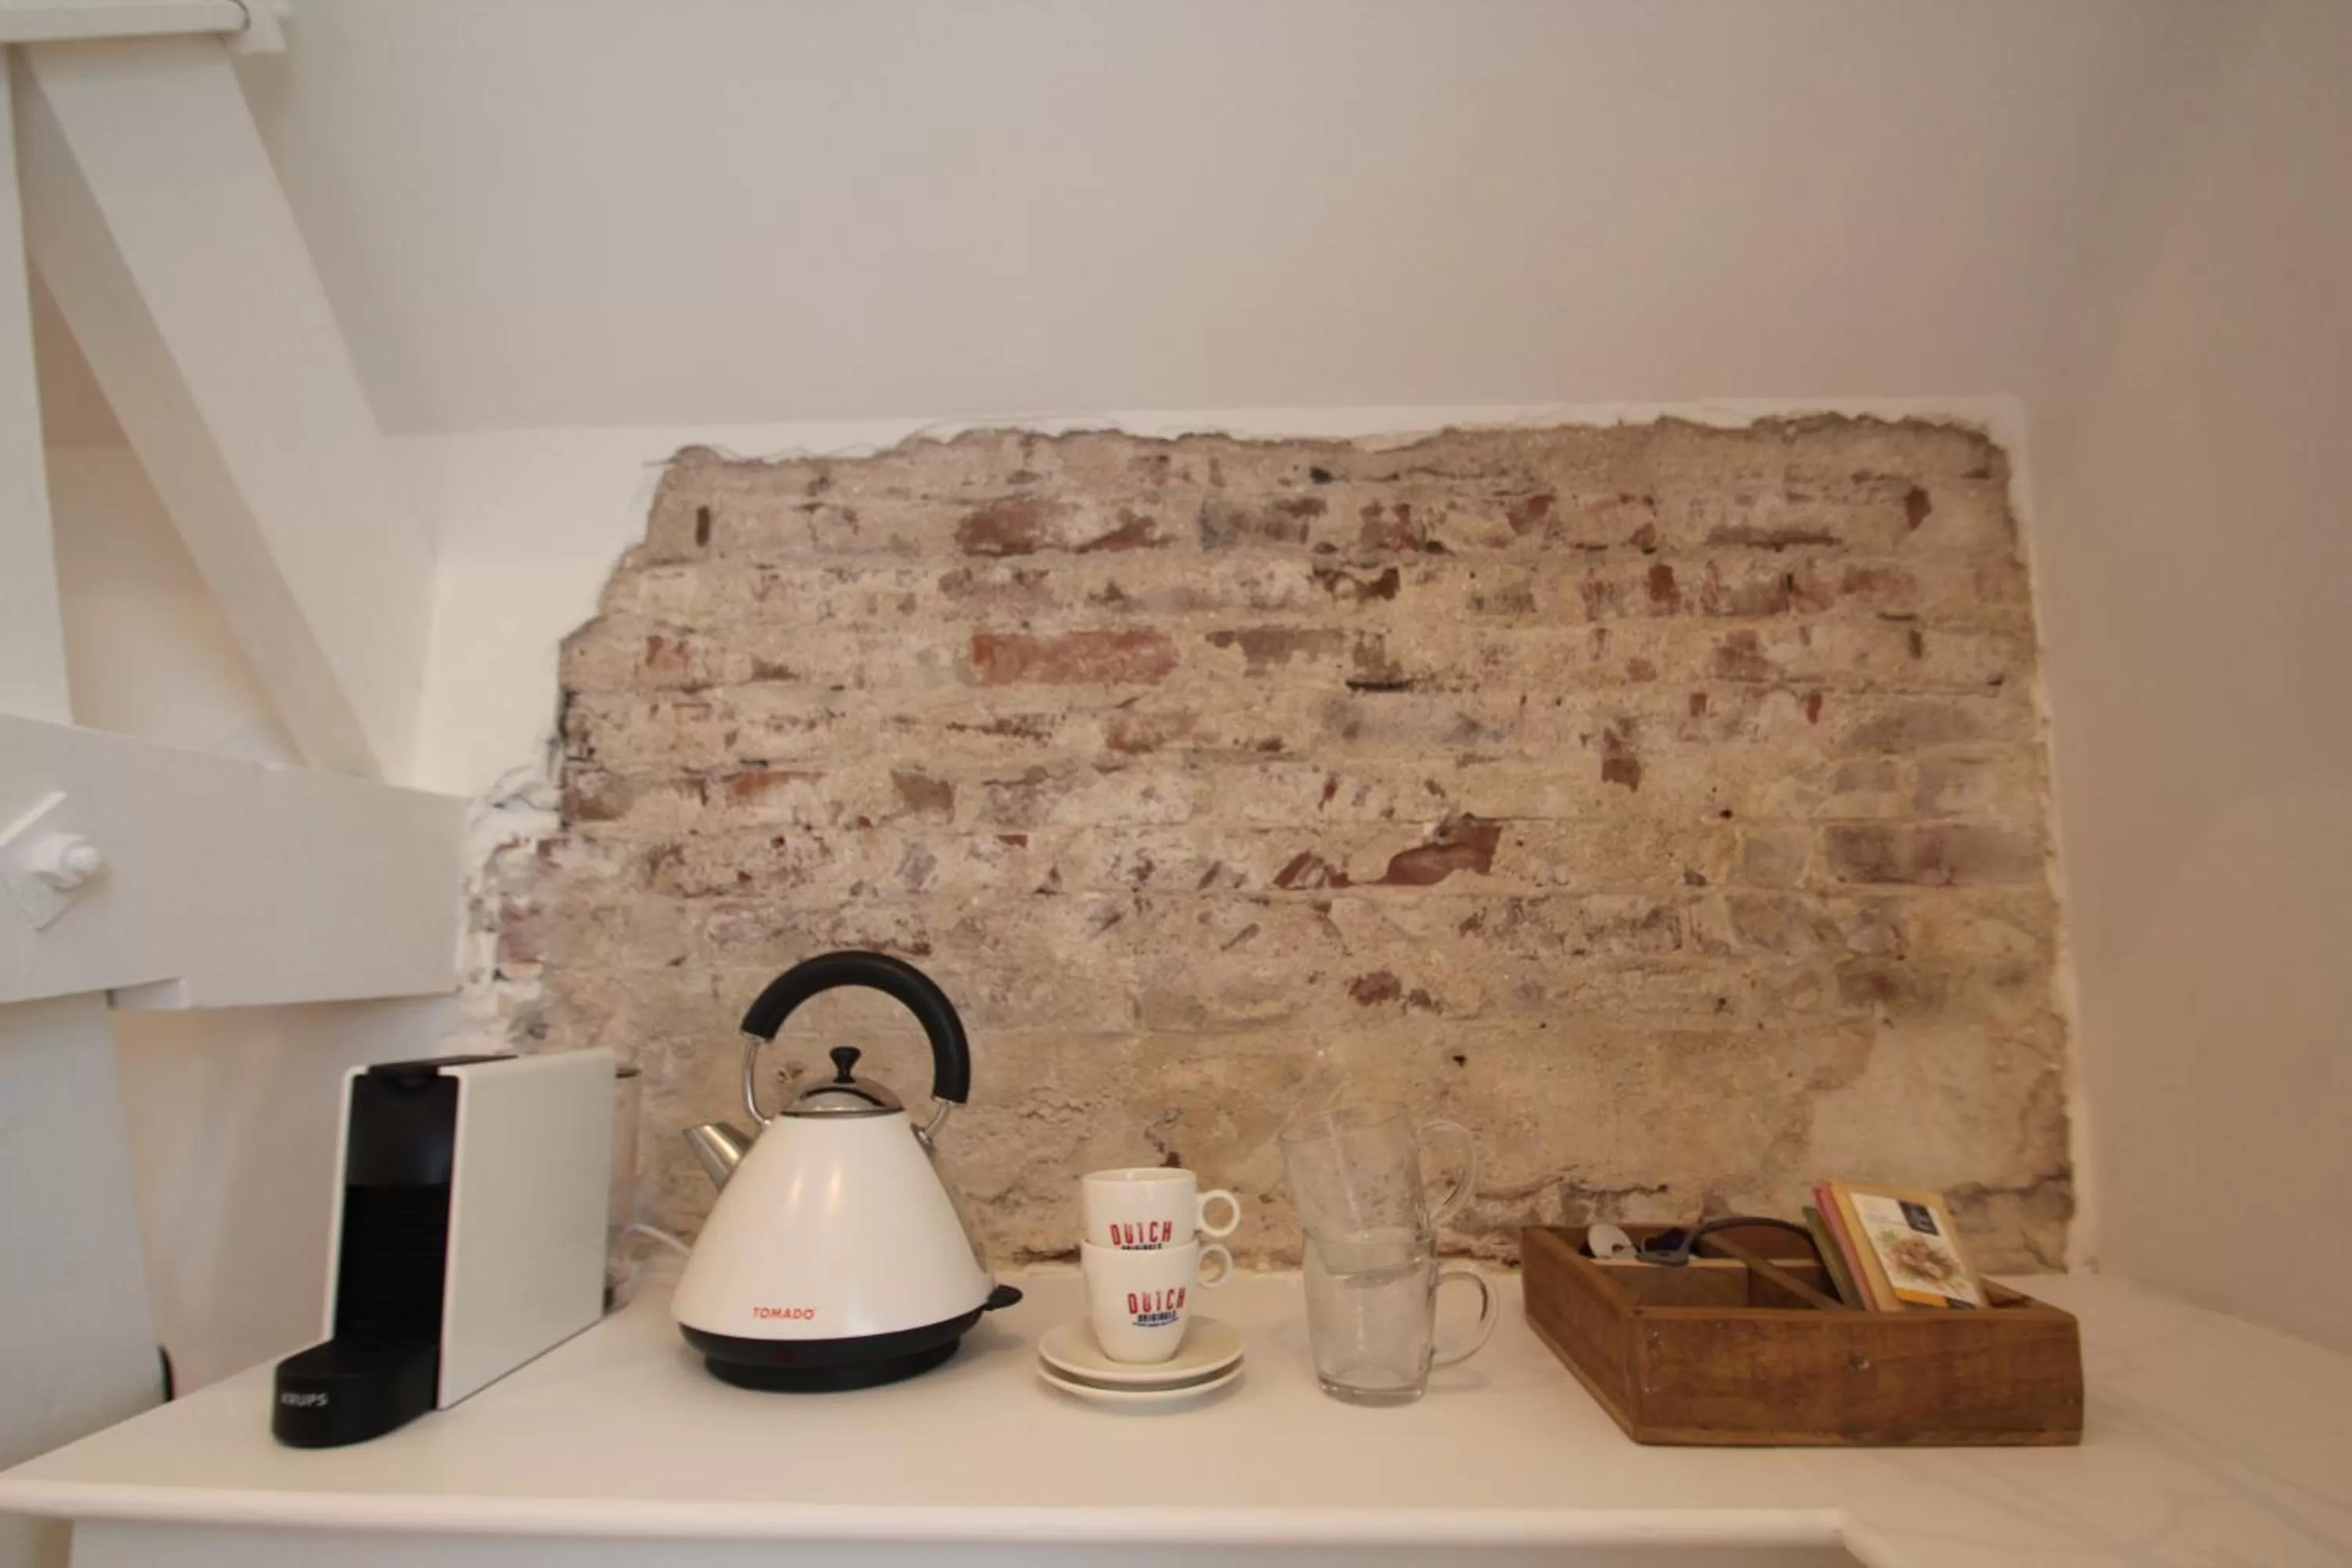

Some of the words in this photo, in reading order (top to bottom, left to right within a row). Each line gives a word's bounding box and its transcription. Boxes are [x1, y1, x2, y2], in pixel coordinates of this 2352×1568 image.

[1110, 1220, 1174, 1246] DUTCH
[1127, 1287, 1186, 1314] DUTCH
[753, 1306, 815, 1319] TOMADO
[281, 1392, 328, 1407] KRUPS
